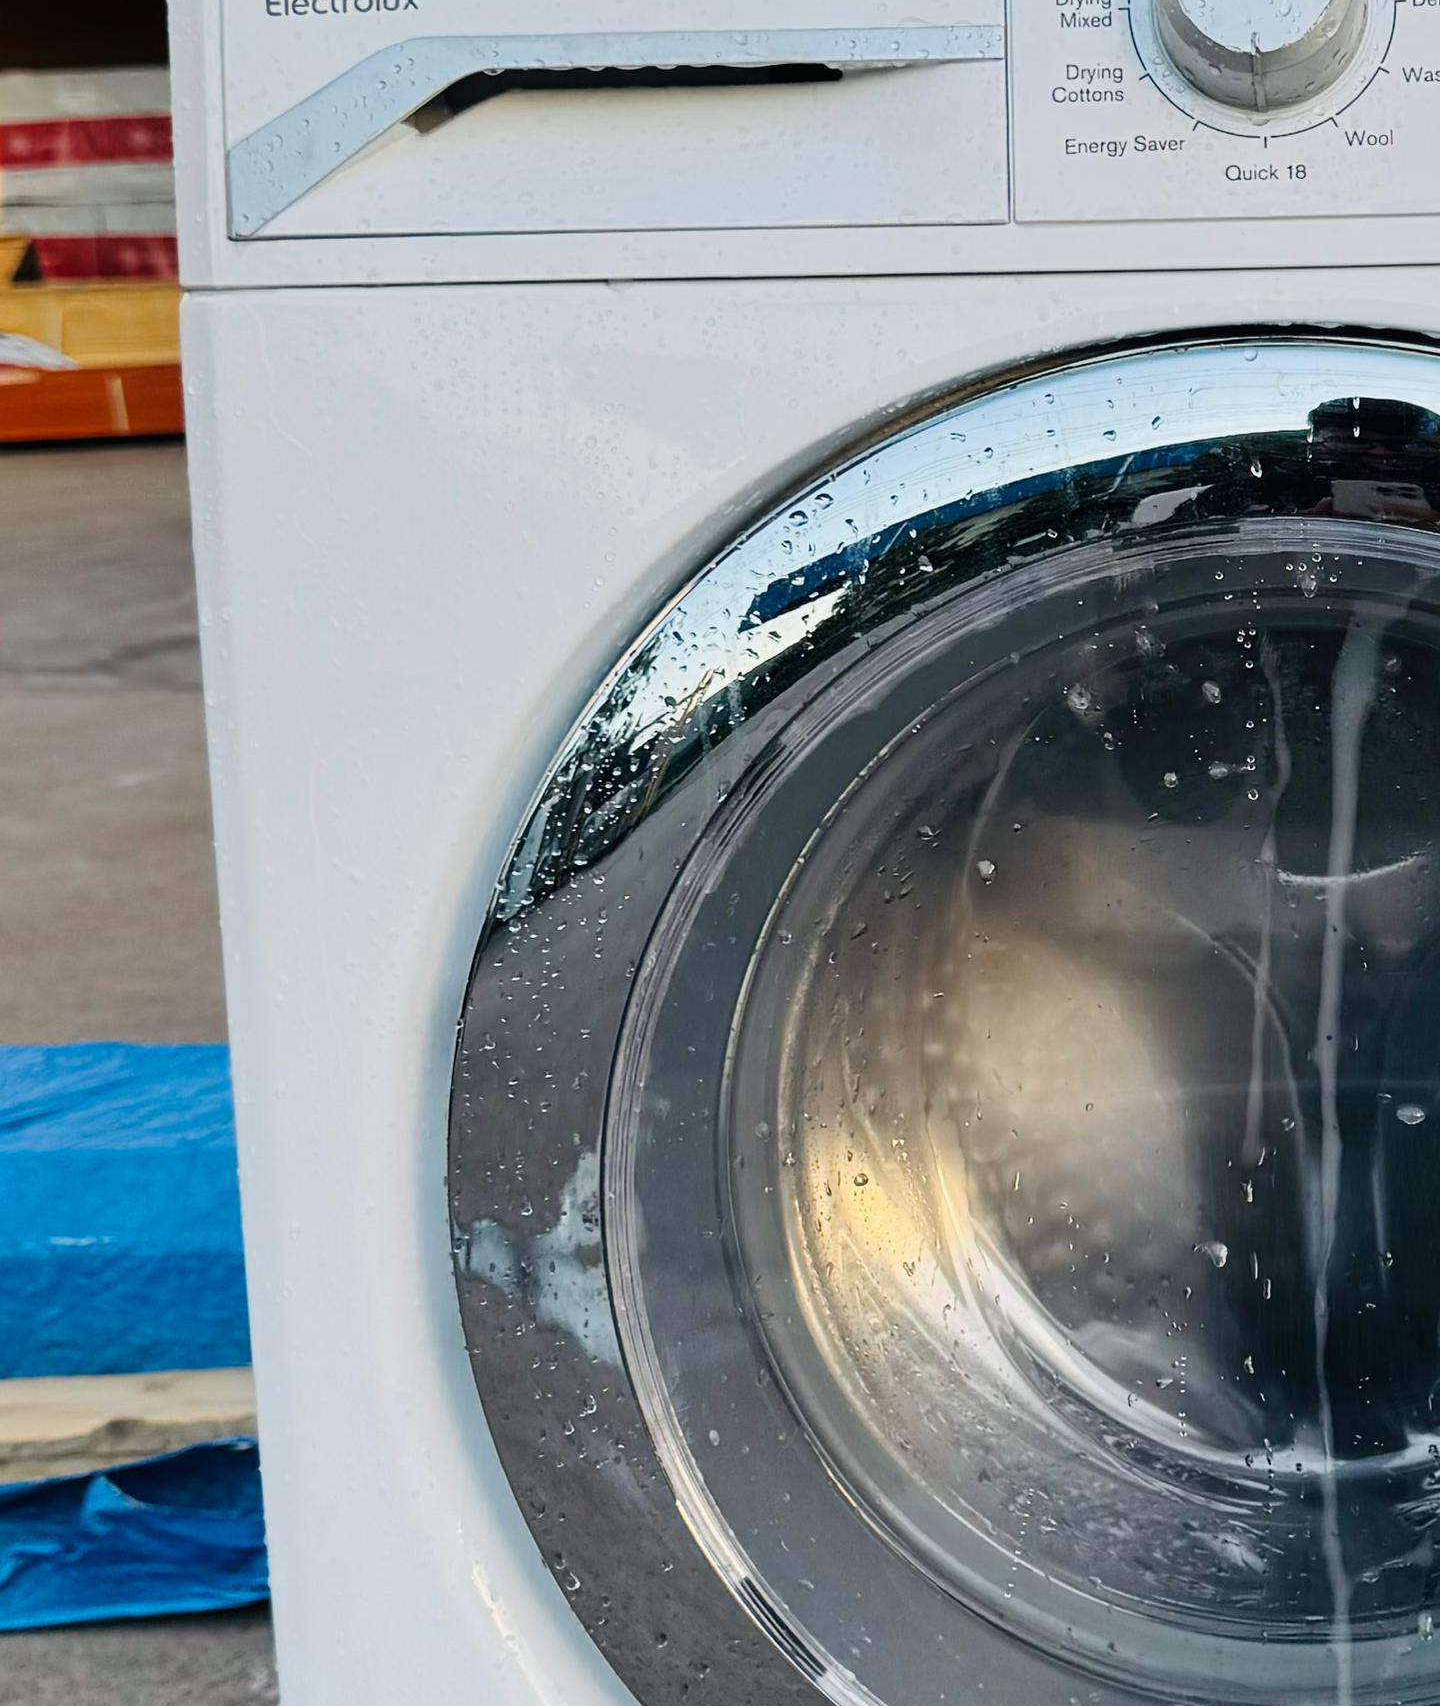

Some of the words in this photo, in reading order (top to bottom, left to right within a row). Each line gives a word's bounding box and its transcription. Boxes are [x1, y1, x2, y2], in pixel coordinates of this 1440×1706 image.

[1060, 12, 1113, 29] Mixed
[1065, 65, 1124, 85] Drying
[1052, 86, 1125, 103] Cottons
[1064, 139, 1127, 158] Energy
[1134, 136, 1186, 153] Saver
[1345, 130, 1394, 147] Wool
[1225, 165, 1278, 182] Quick
[1286, 165, 1307, 180] 18
